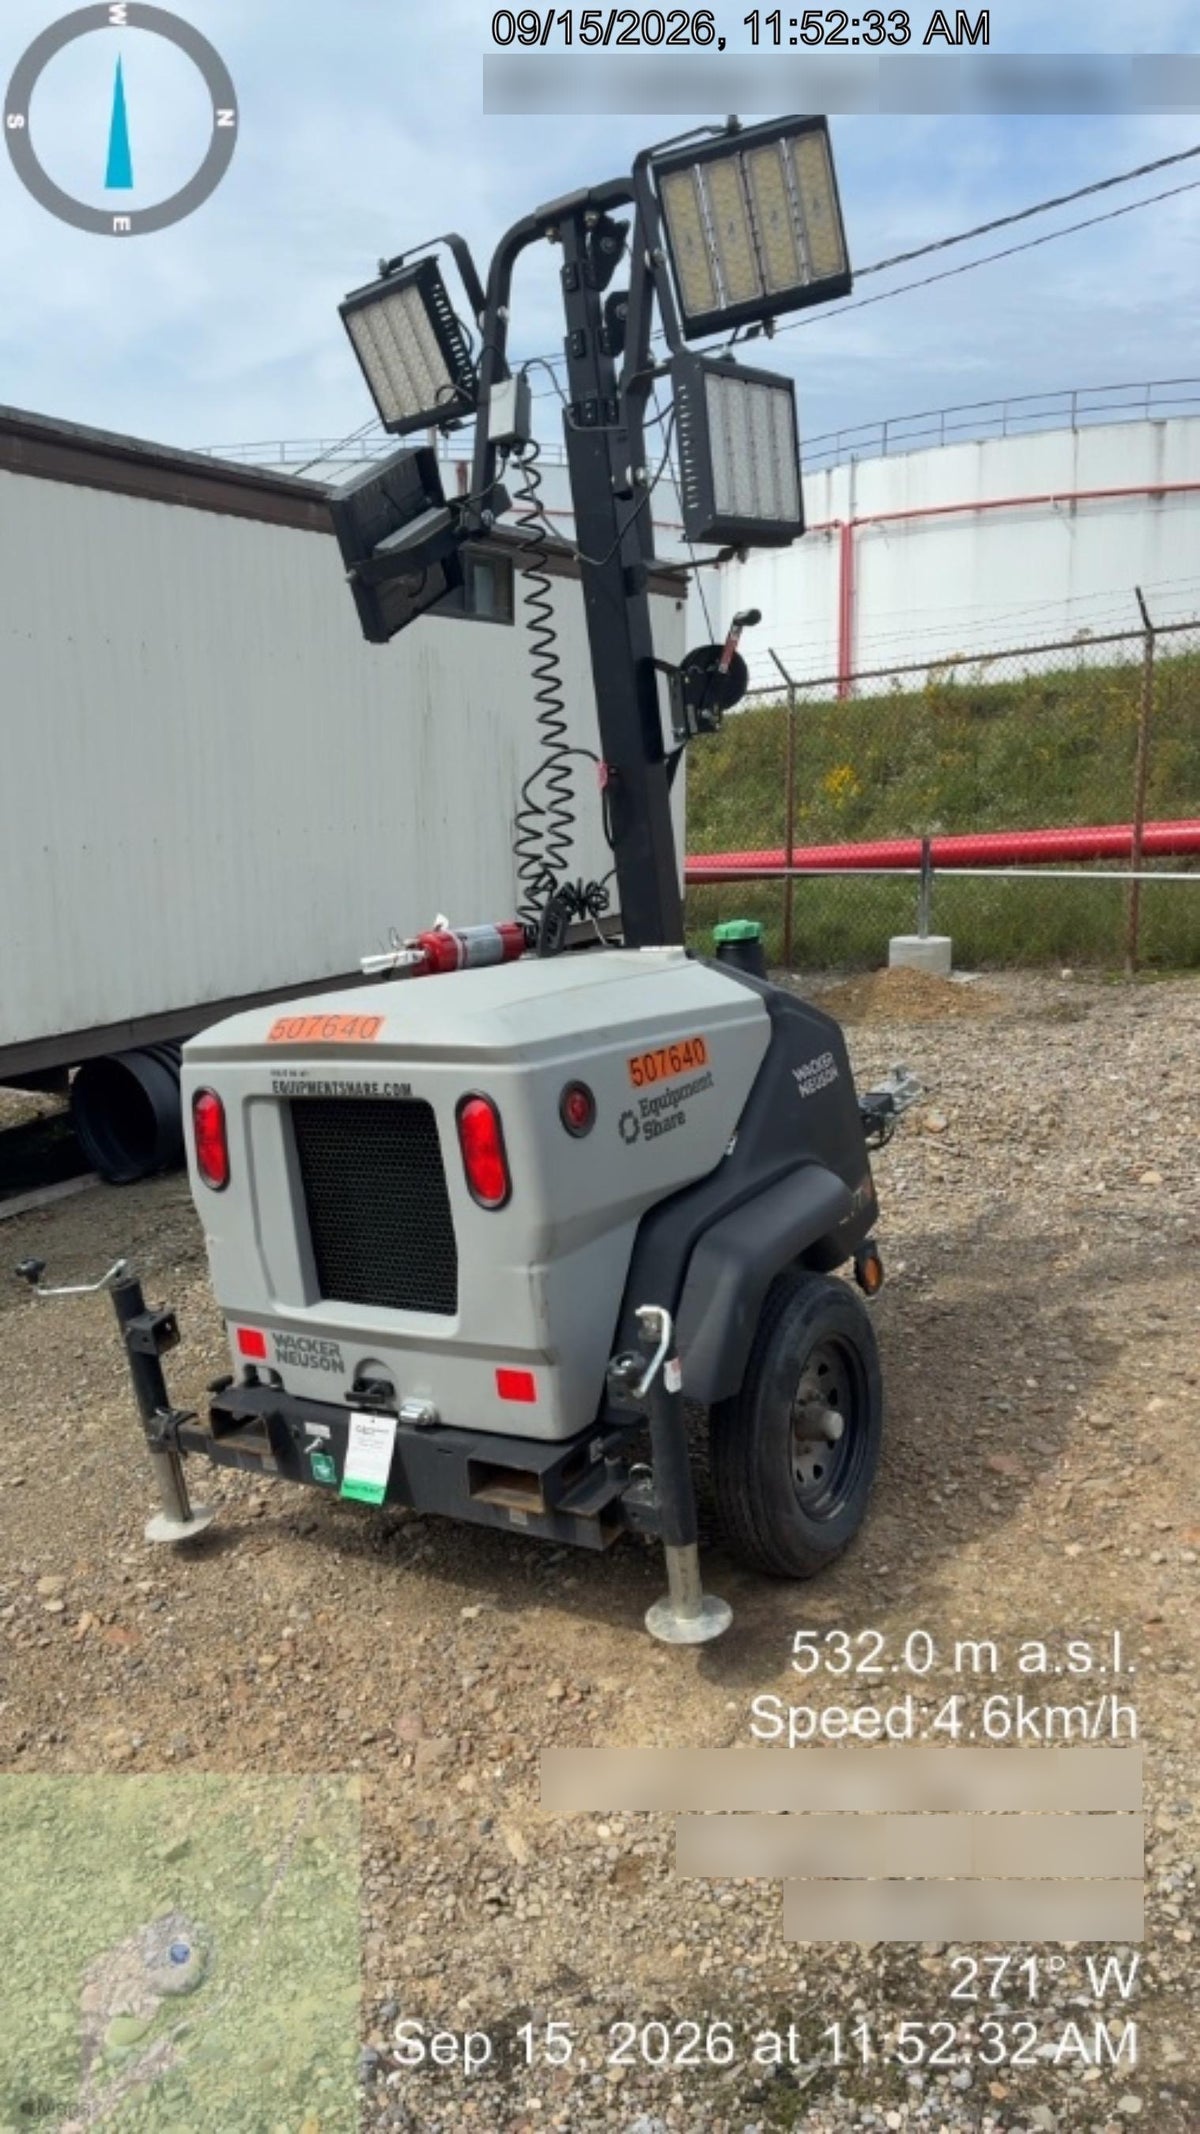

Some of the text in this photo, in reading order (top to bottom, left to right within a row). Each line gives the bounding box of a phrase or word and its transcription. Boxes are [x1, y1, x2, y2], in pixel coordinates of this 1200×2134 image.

[268, 1013, 381, 1041] 507640
[629, 1037, 706, 1087] 507640
[271, 1080, 412, 1097] EQUIPMENTSHARE.COM
[638, 1071, 715, 1119] Equipment
[643, 1110, 686, 1142] Share
[272, 1332, 341, 1356] WACKER
[275, 1349, 345, 1374] NEUSON
